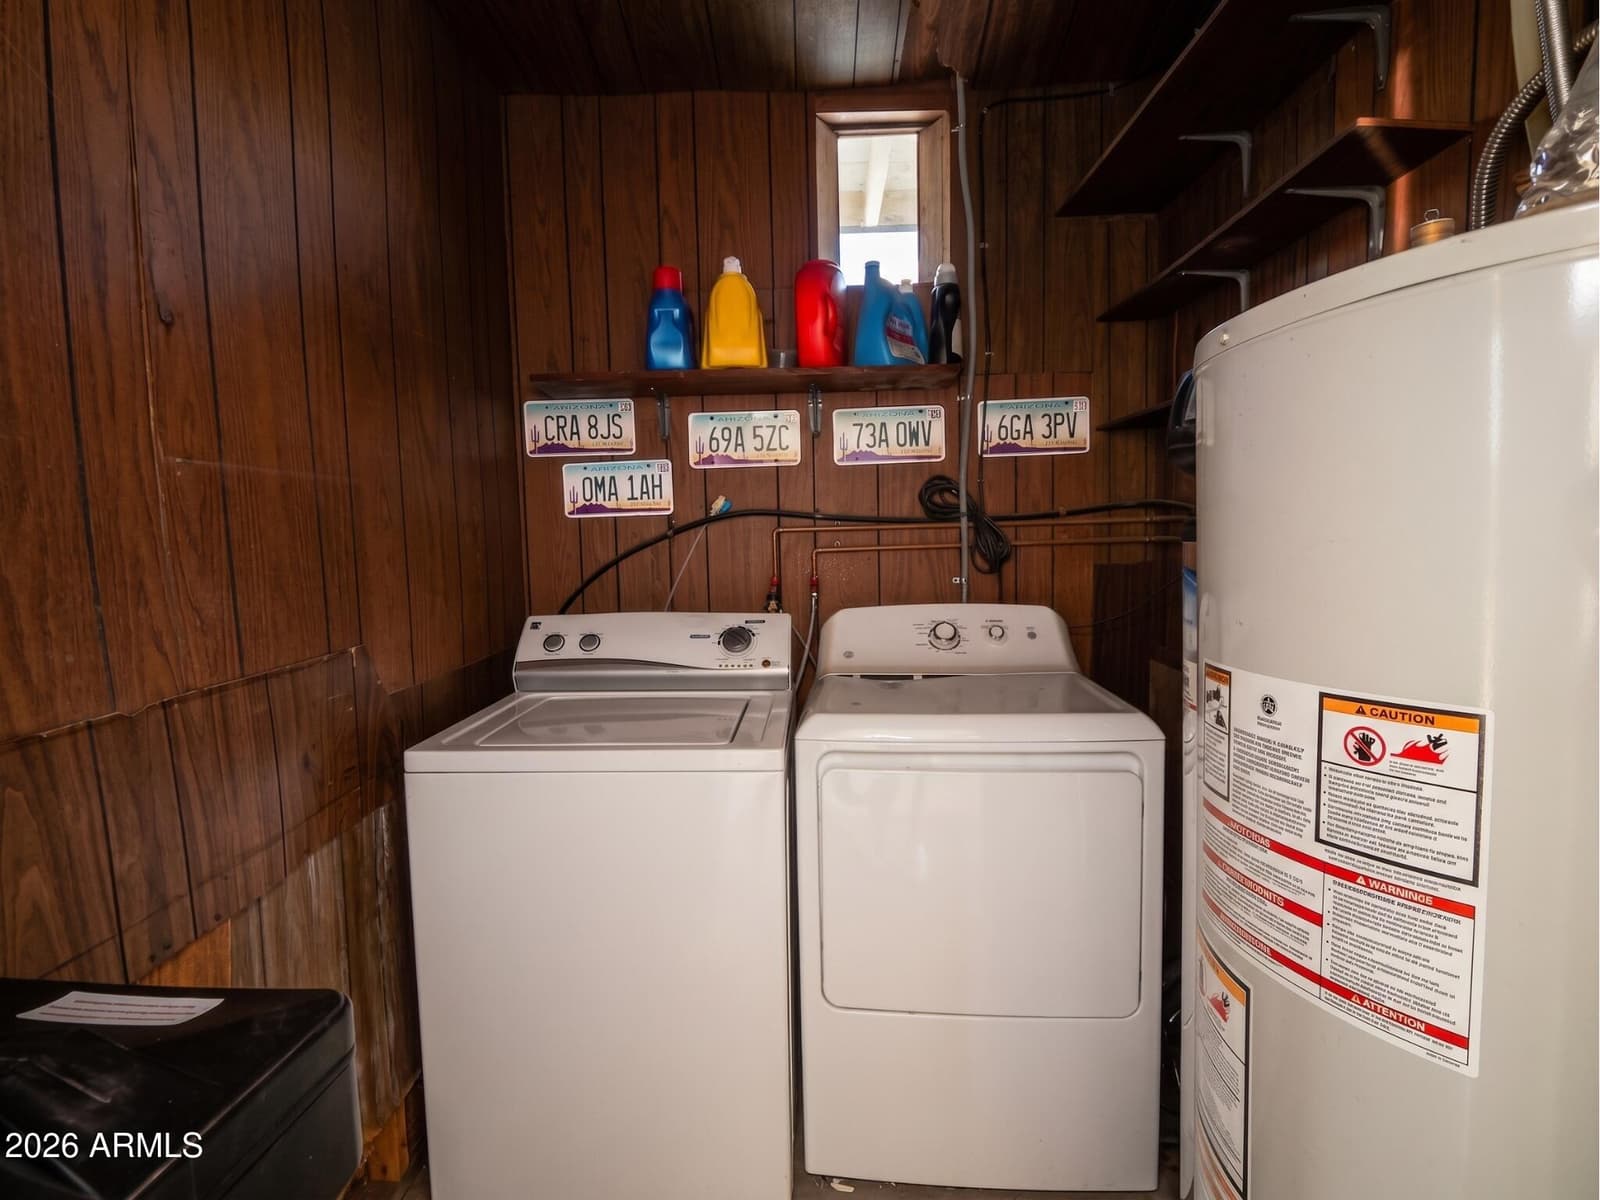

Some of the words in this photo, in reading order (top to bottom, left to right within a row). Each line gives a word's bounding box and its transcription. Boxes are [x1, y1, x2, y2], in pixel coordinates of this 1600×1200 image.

[544, 415, 581, 441] CRA
[588, 413, 623, 440] 8JS
[709, 426, 745, 453] 69A
[753, 424, 790, 452] 5ZC
[852, 422, 889, 449] 73A
[997, 413, 1034, 441] 6GA
[1041, 412, 1077, 439] 3PV
[591, 464, 644, 472] ARIZONA
[627, 473, 663, 500] 1AH
[1369, 707, 1436, 726] CAUTION
[1362, 1000, 1426, 1032] ATTENTION
